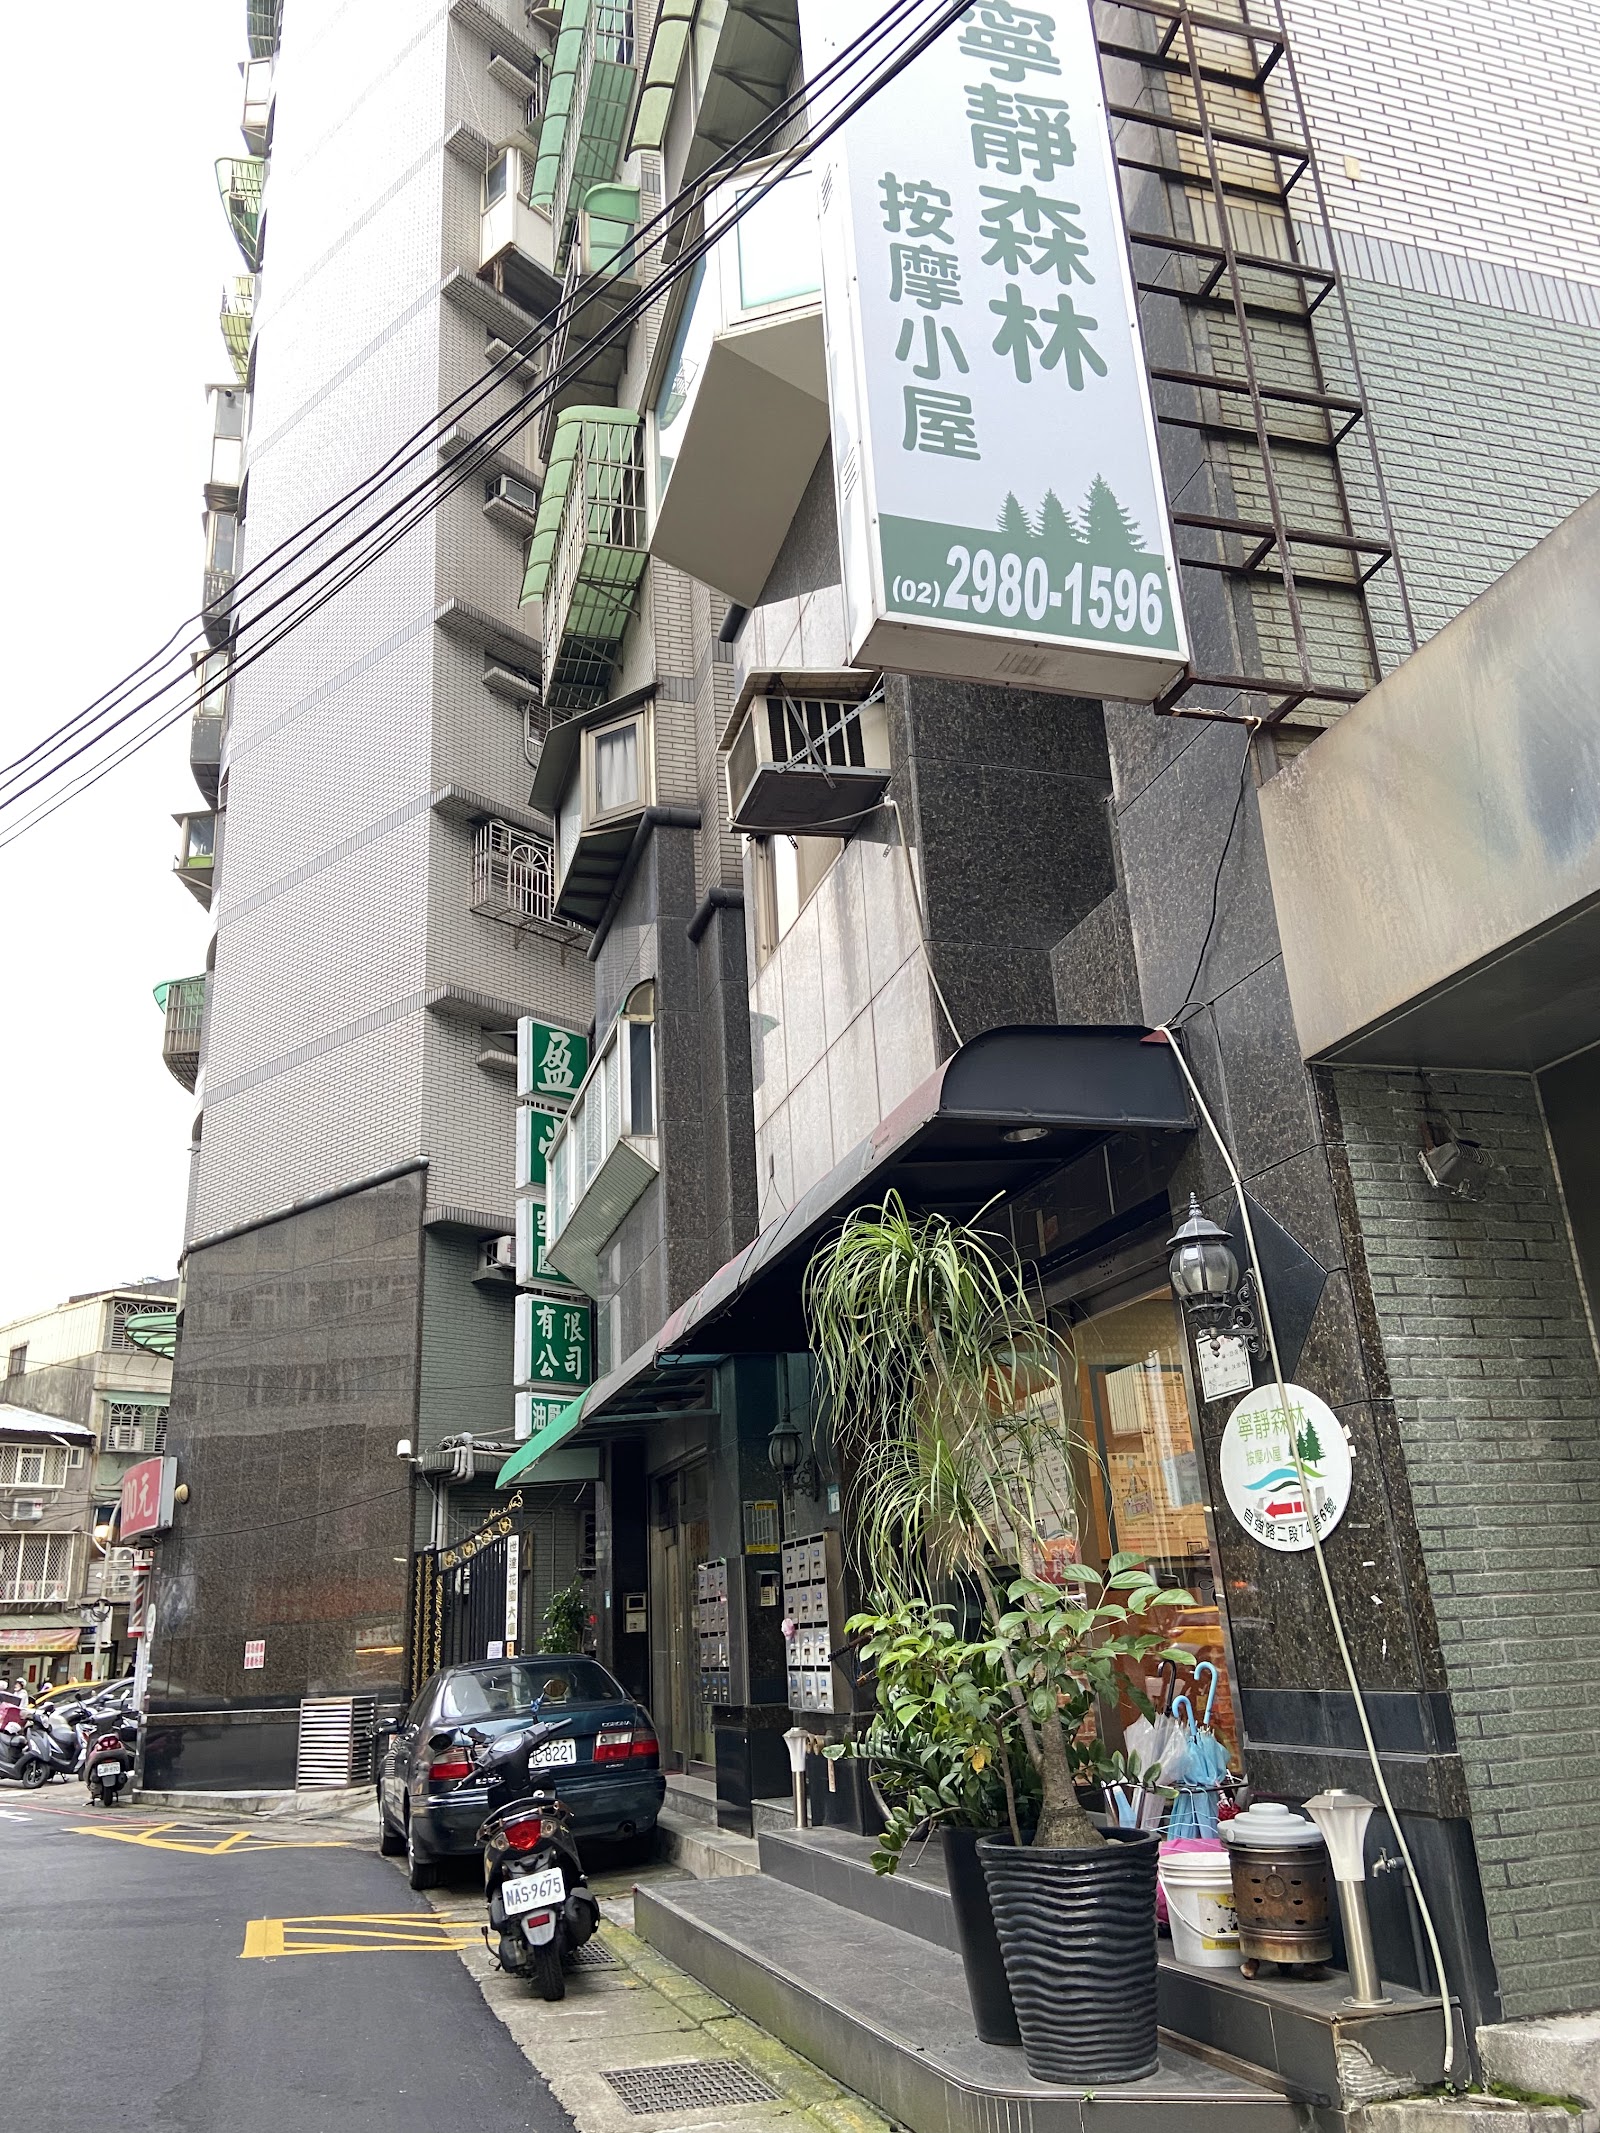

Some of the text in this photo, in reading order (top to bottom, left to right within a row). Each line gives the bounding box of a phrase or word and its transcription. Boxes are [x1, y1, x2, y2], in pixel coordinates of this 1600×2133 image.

[957, 0, 1108, 392] 寧靜森林
[878, 171, 982, 462] 按摩小屋
[537, 1031, 580, 1096] 盈
[1236, 1401, 1308, 1442] 寧靜森林
[1246, 1446, 1282, 1466] 按摩小屋
